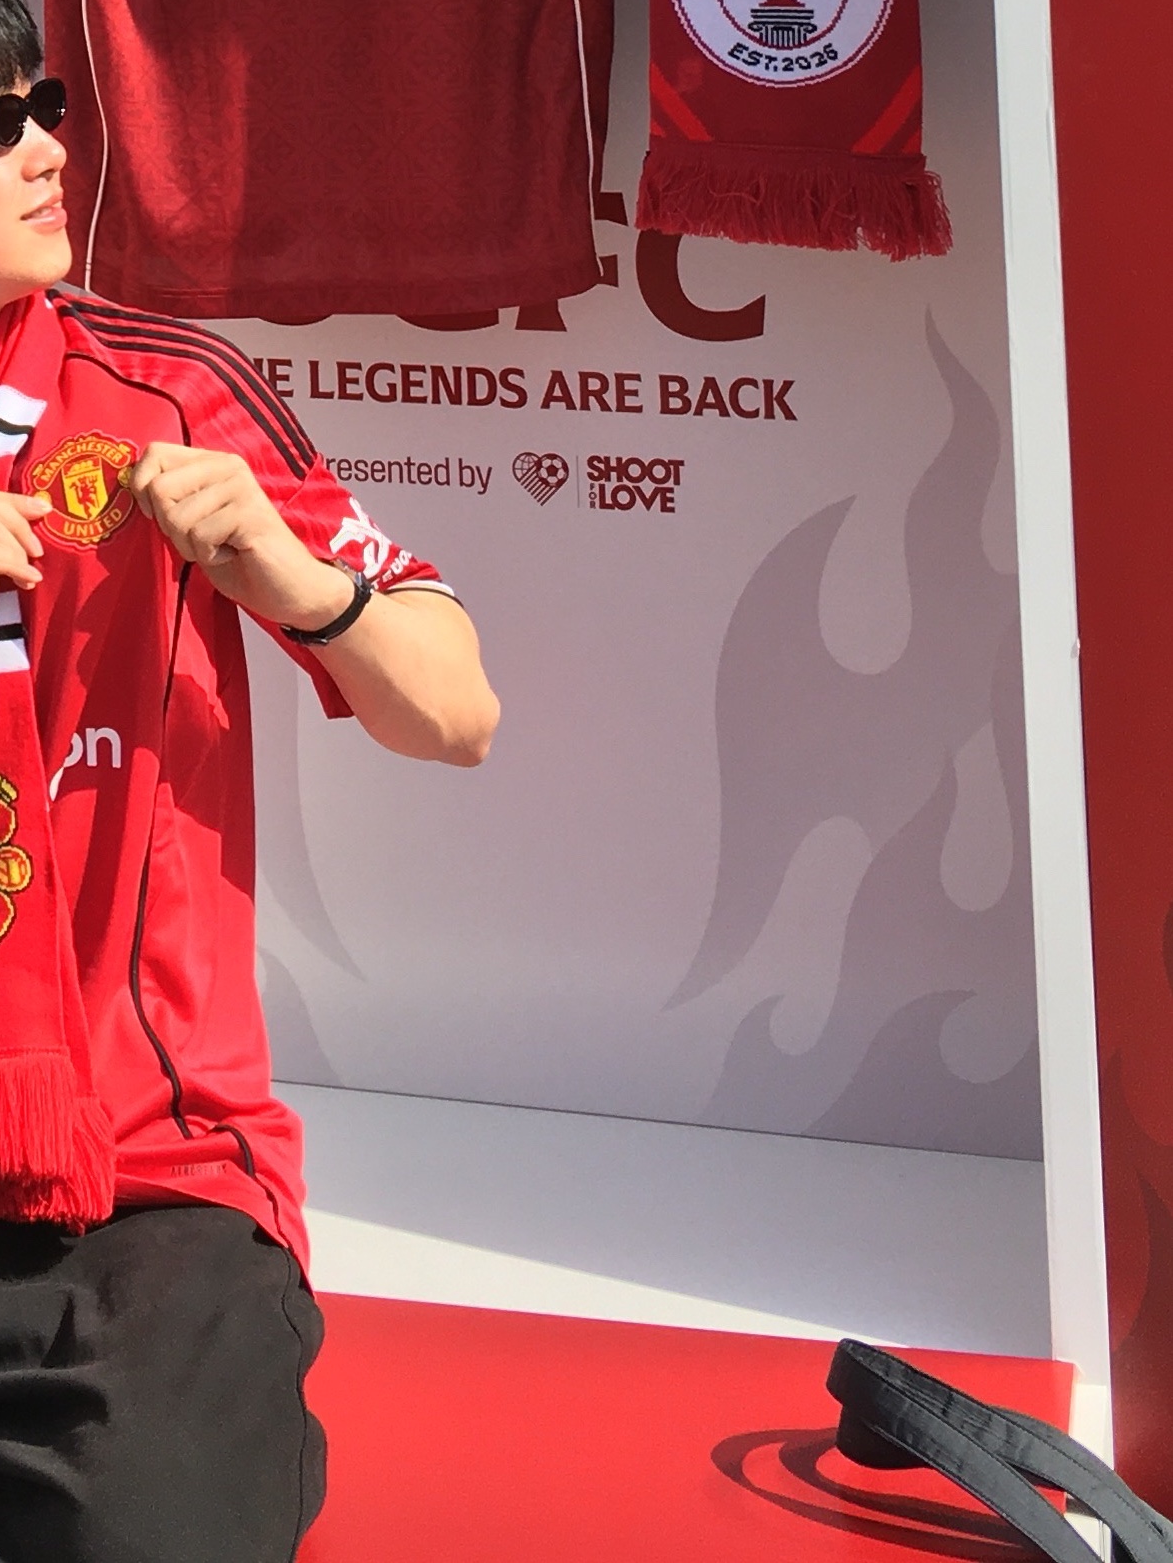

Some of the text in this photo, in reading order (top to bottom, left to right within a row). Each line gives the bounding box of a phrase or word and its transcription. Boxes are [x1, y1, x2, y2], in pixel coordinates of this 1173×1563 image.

[308, 360, 527, 409] LEGENDS
[540, 370, 643, 413] ARE
[659, 374, 798, 421] BACK
[40, 440, 123, 483] MANCHESTER
[326, 455, 493, 495] resented by
[587, 455, 685, 485] SHOOT
[598, 483, 676, 513] LOVE
[62, 507, 122, 537] UNITED
